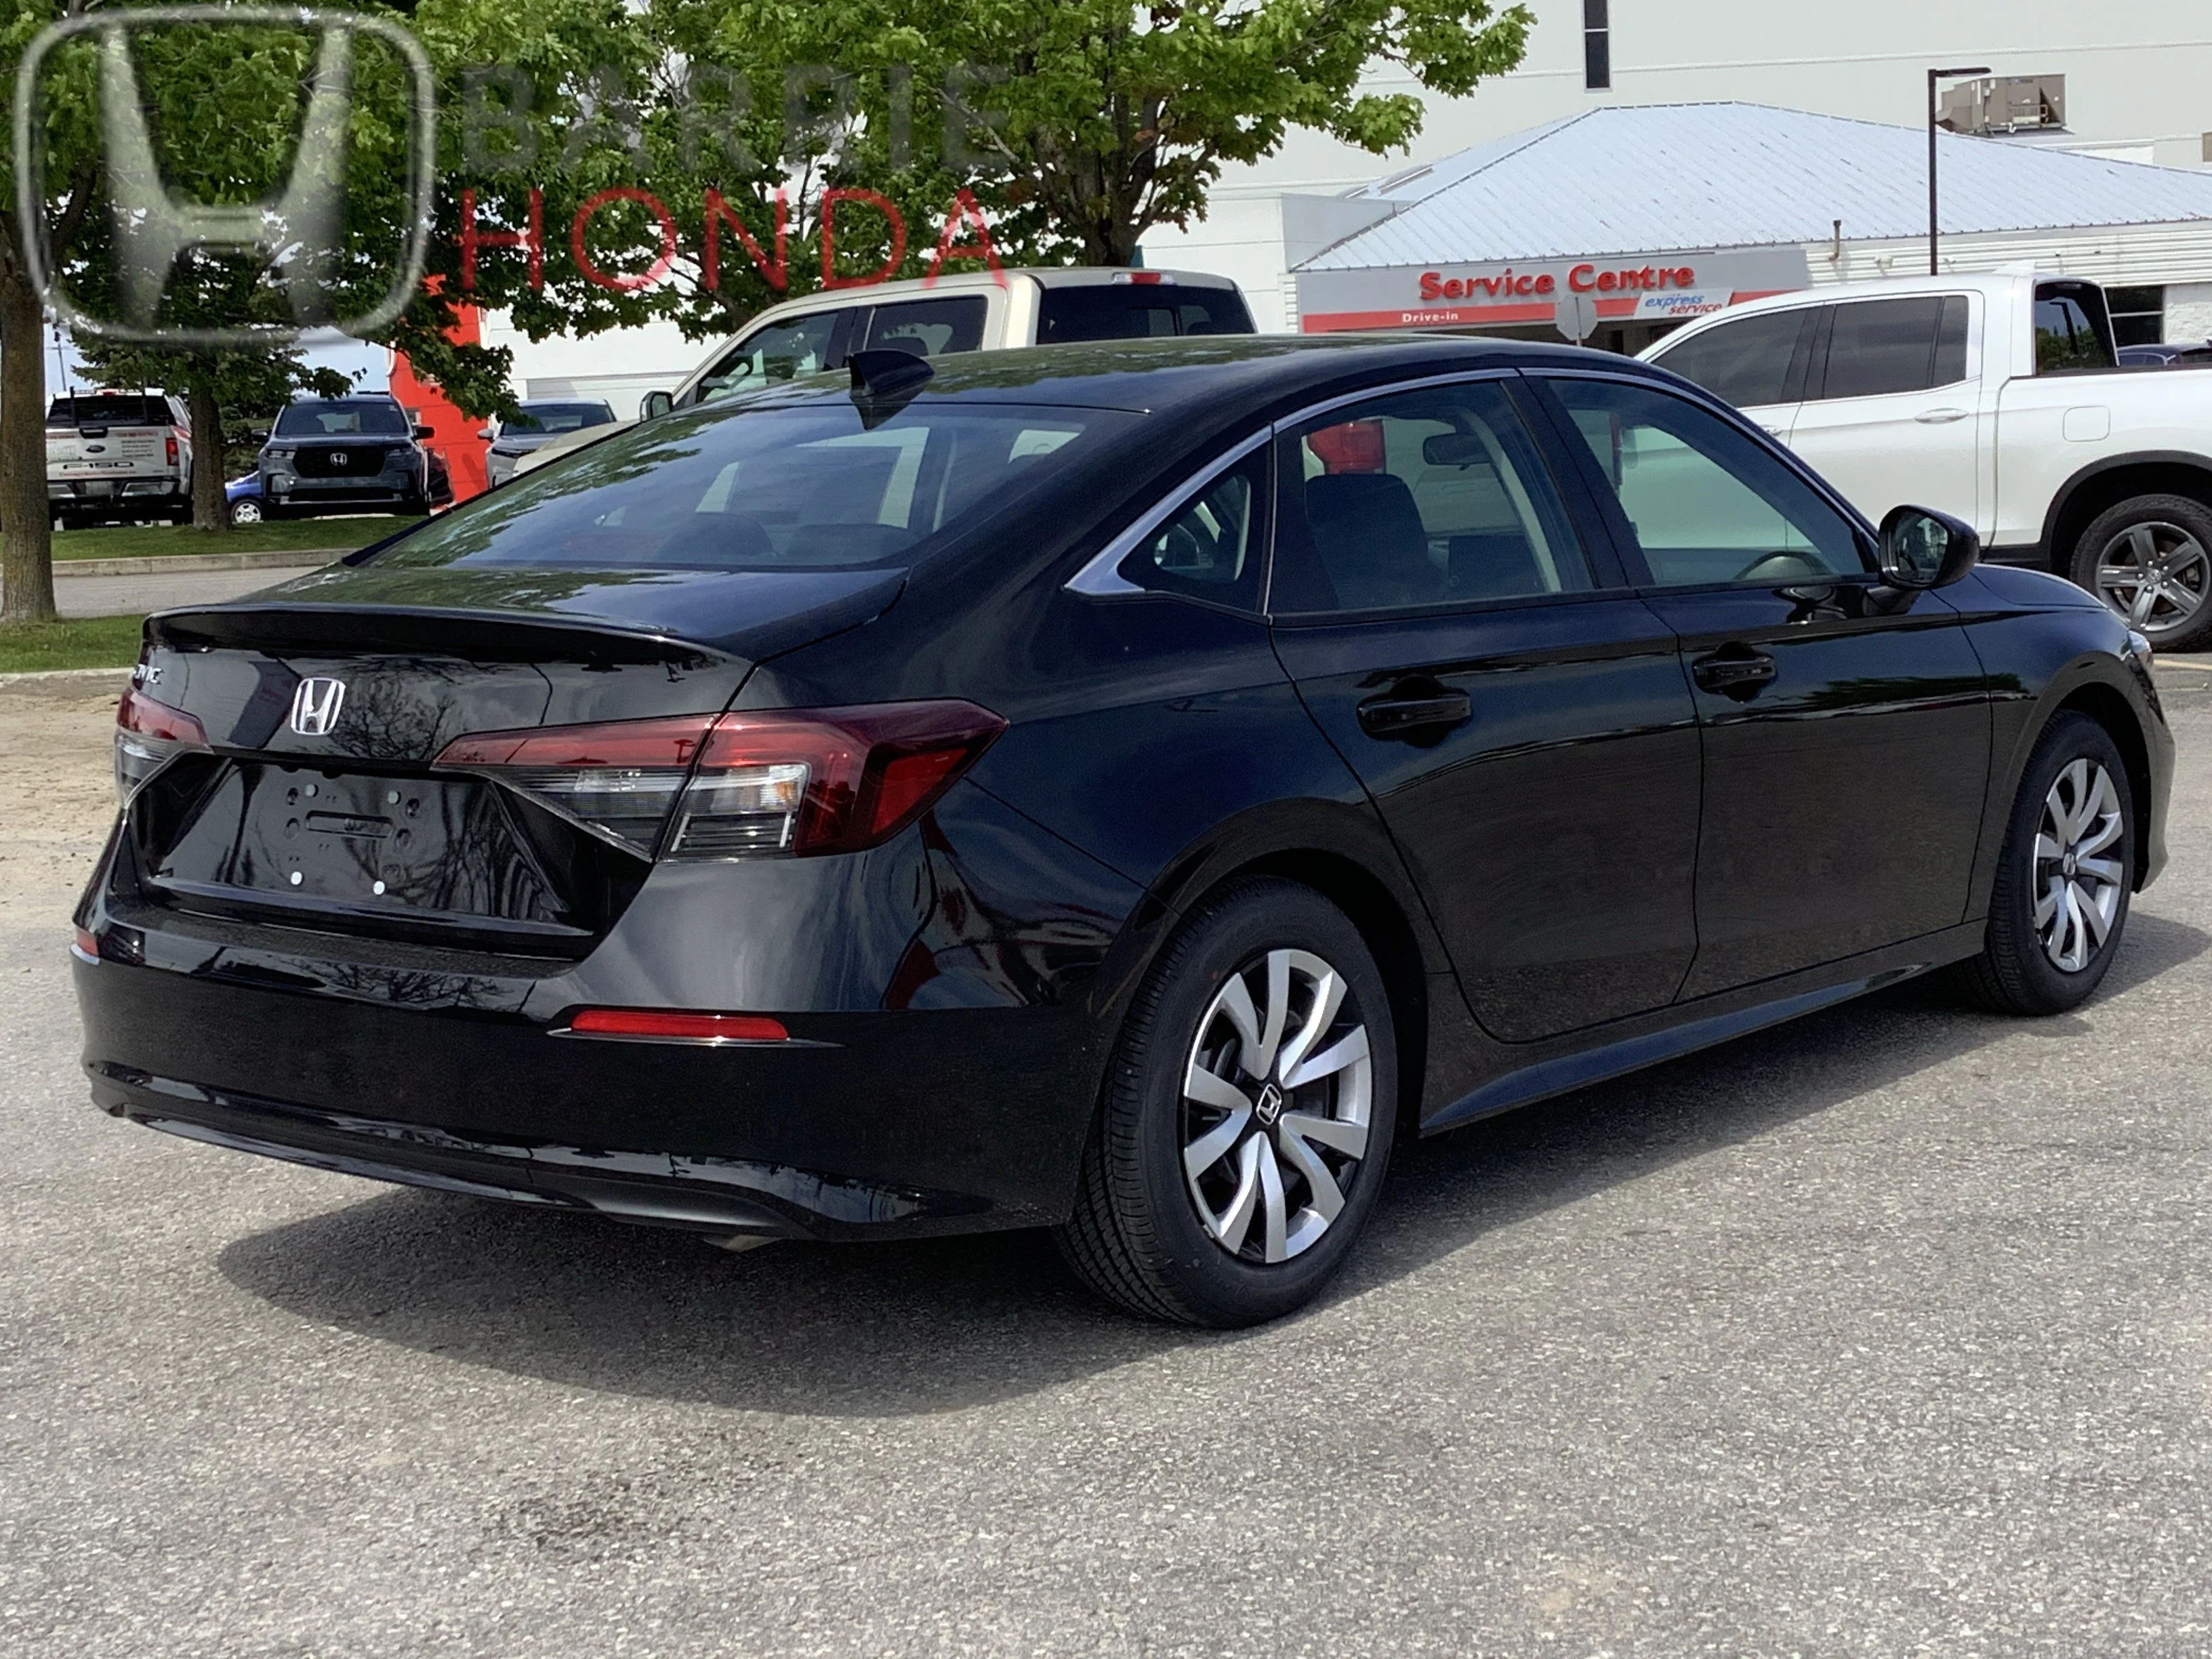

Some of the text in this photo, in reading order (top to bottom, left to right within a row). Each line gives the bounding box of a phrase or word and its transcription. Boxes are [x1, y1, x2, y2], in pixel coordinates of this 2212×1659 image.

[1419, 264, 1694, 300] Service Centre
[1645, 294, 1704, 310] express
[1668, 303, 1723, 314] service
[1402, 311, 1458, 323] Drive-in
